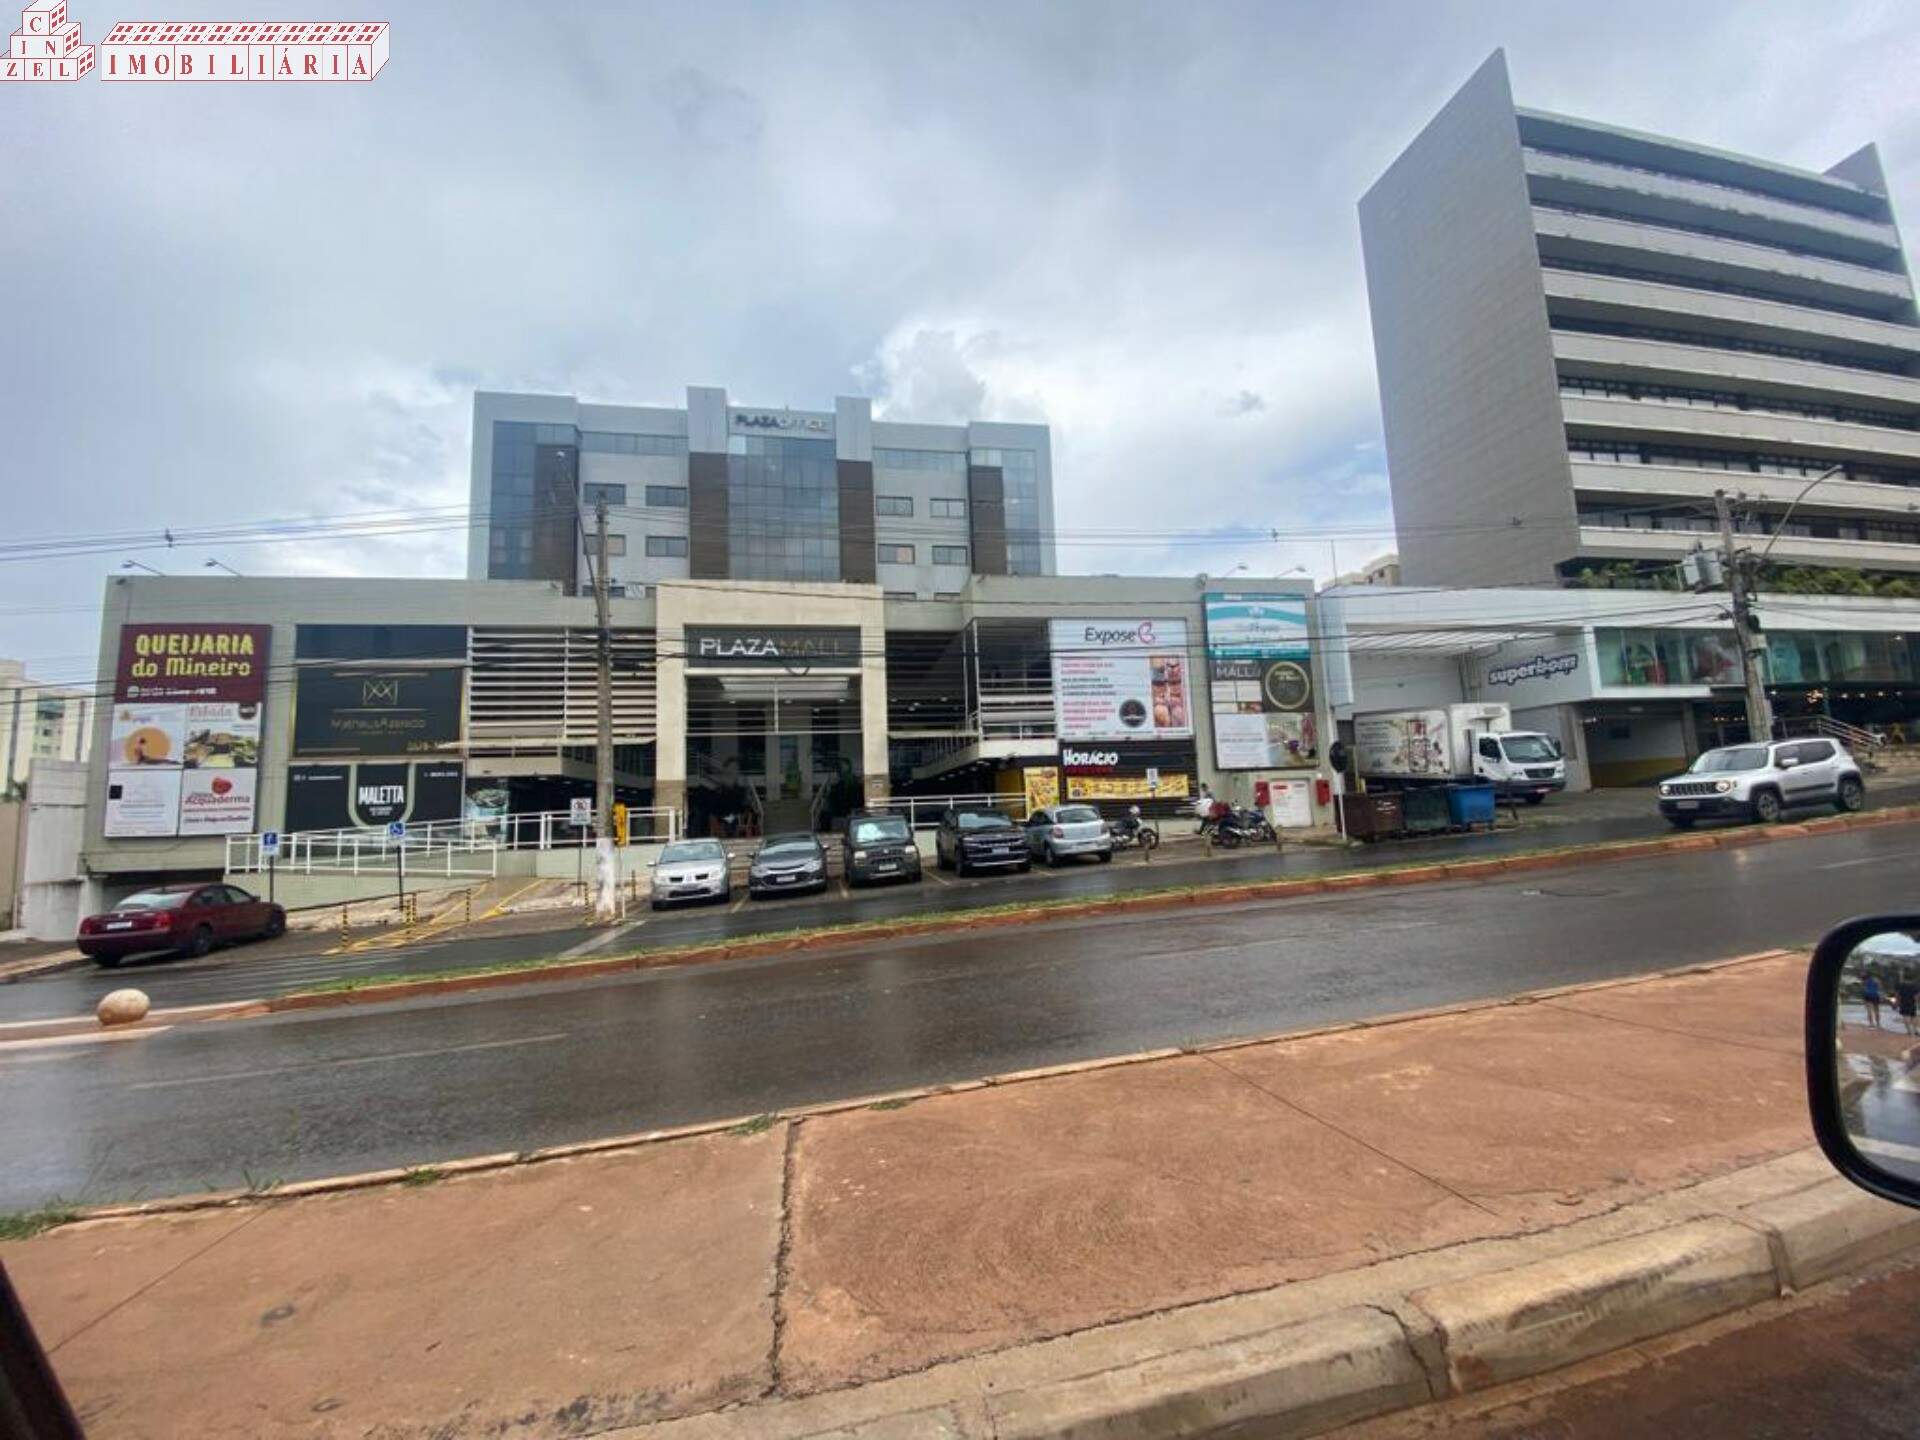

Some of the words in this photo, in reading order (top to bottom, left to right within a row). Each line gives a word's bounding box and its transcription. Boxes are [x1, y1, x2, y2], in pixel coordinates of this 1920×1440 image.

[135, 633, 254, 657] QUEIJARIA
[1084, 626, 1137, 645] Expose
[700, 638, 779, 656] PLAZA
[131, 658, 158, 678] do
[164, 656, 251, 677] Mineiro
[1488, 655, 1577, 685] superbom
[358, 785, 404, 805] MALETTA
